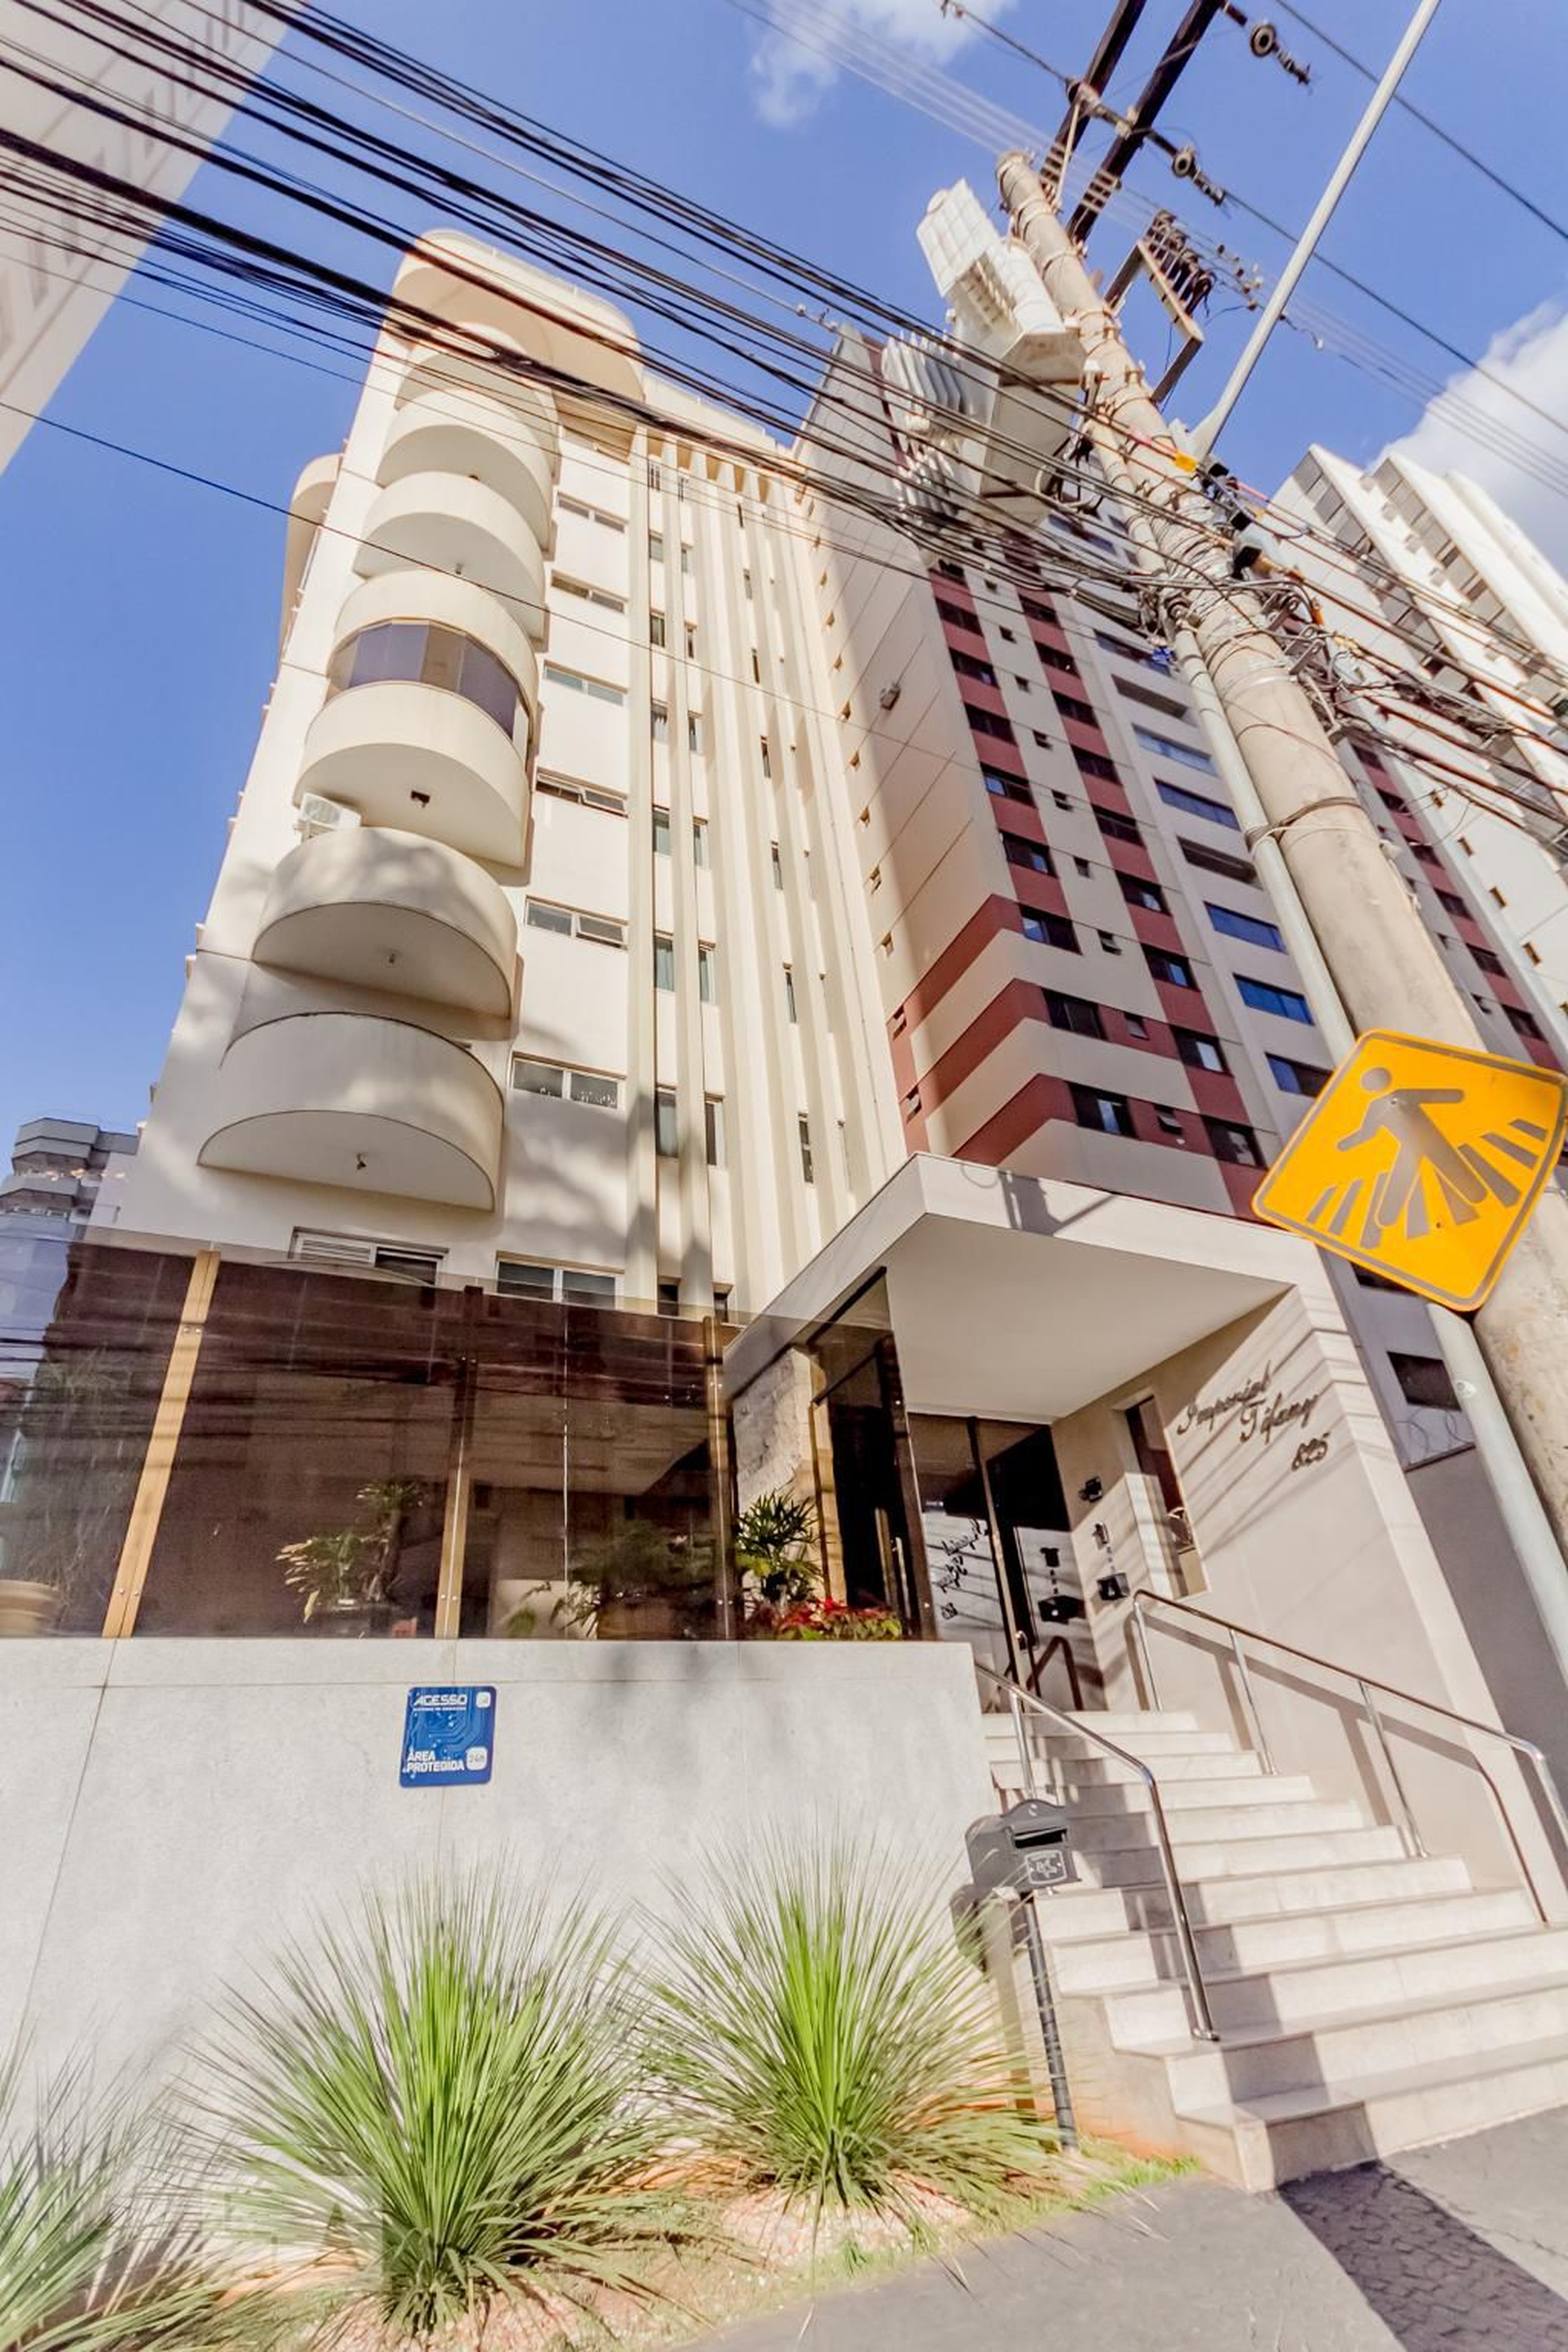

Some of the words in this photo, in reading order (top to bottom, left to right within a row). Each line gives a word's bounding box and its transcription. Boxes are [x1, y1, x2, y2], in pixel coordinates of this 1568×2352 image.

[1177, 1360, 1271, 1435] Imperial
[414, 1694, 468, 1706] ACESSO
[407, 1760, 465, 1773] PROTEGIDA
